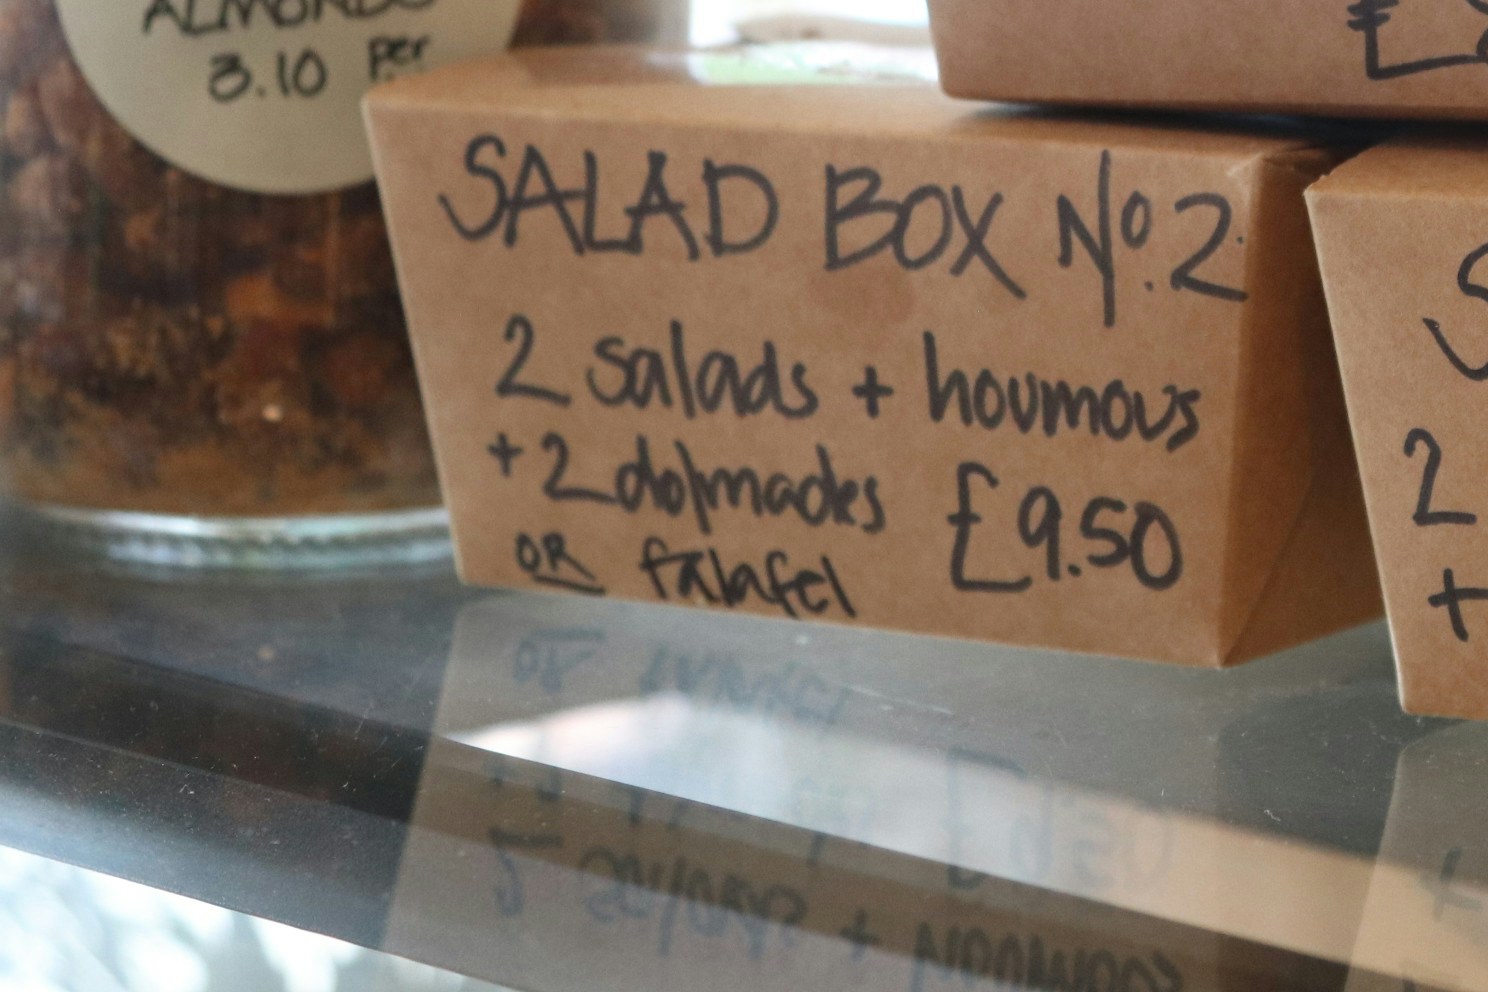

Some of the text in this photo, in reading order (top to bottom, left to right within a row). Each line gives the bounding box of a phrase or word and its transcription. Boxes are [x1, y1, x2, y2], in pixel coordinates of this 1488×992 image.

[437, 133, 779, 262] SALAD
[824, 162, 1027, 300] BOX
[495, 313, 1201, 452] 2 salads + houmous
[612, 434, 886, 535] dolmades
[946, 460, 1184, 593] £9.50
[1403, 427, 1478, 526] 2
[514, 531, 857, 619] OR falafel
